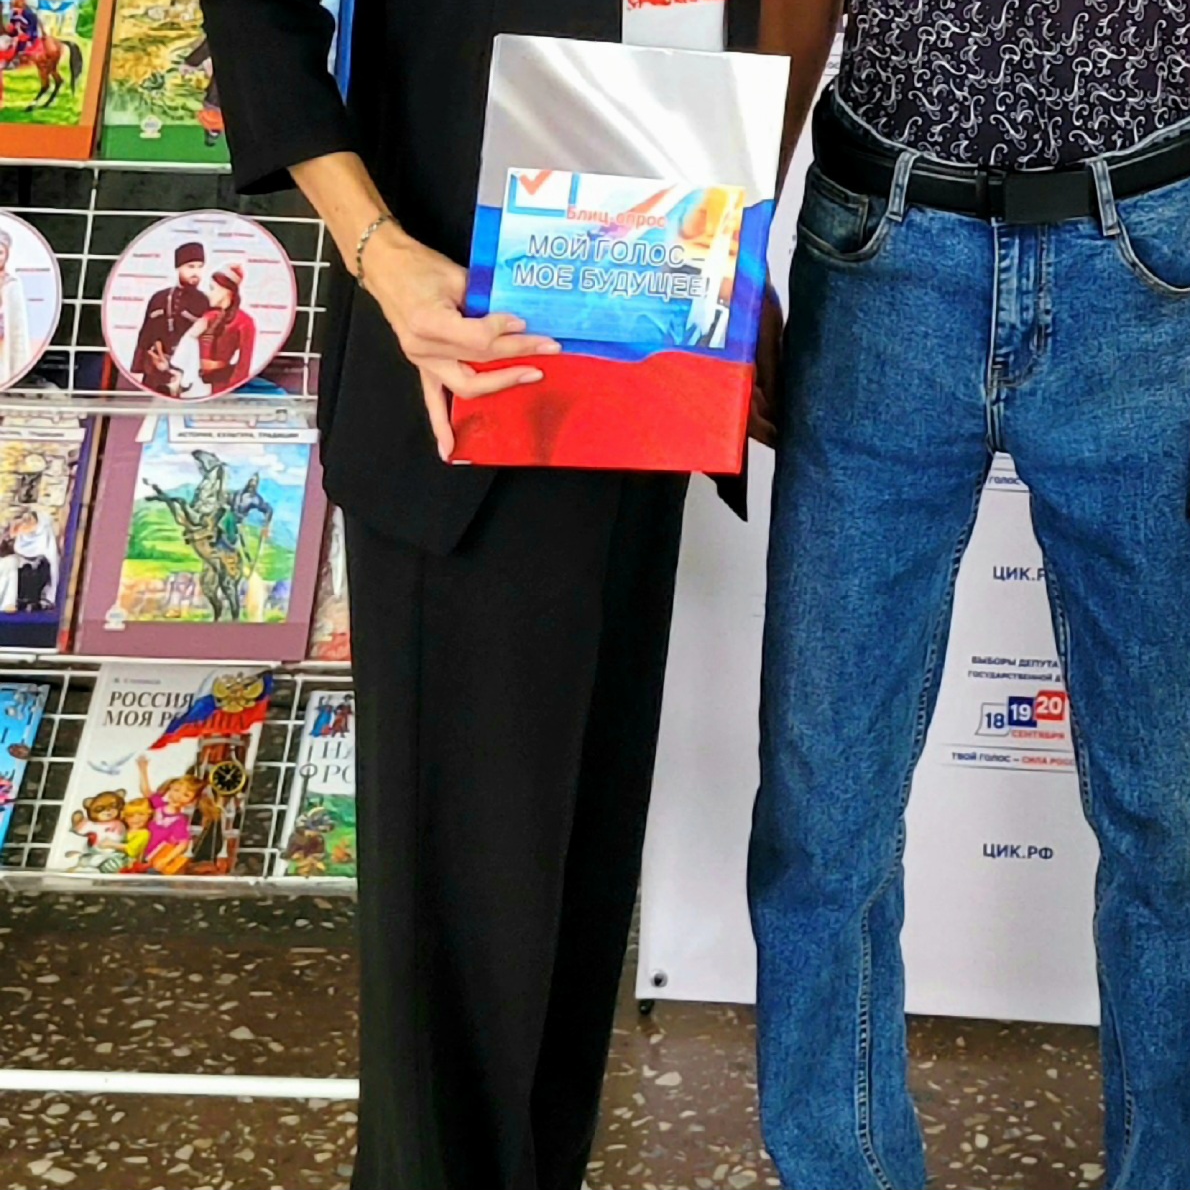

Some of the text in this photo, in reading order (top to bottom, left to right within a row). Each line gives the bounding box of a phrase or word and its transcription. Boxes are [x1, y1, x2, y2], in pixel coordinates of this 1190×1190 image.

[528, 233, 588, 260] МОЙ
[596, 238, 685, 266] ГОЛОС
[579, 270, 710, 301] БУДУЩЕЕ!
[993, 566, 1045, 581] ЦИК.Р
[971, 655, 1059, 668] ВЫБОРЫ ДЕПУТА
[109, 691, 197, 708] РОССИЯ
[103, 711, 152, 727] МОЯ
[984, 696, 1063, 729] 18 19 20
[1050, 757, 1075, 766] РОСС
[983, 844, 1054, 860] ЦИК.РФ
